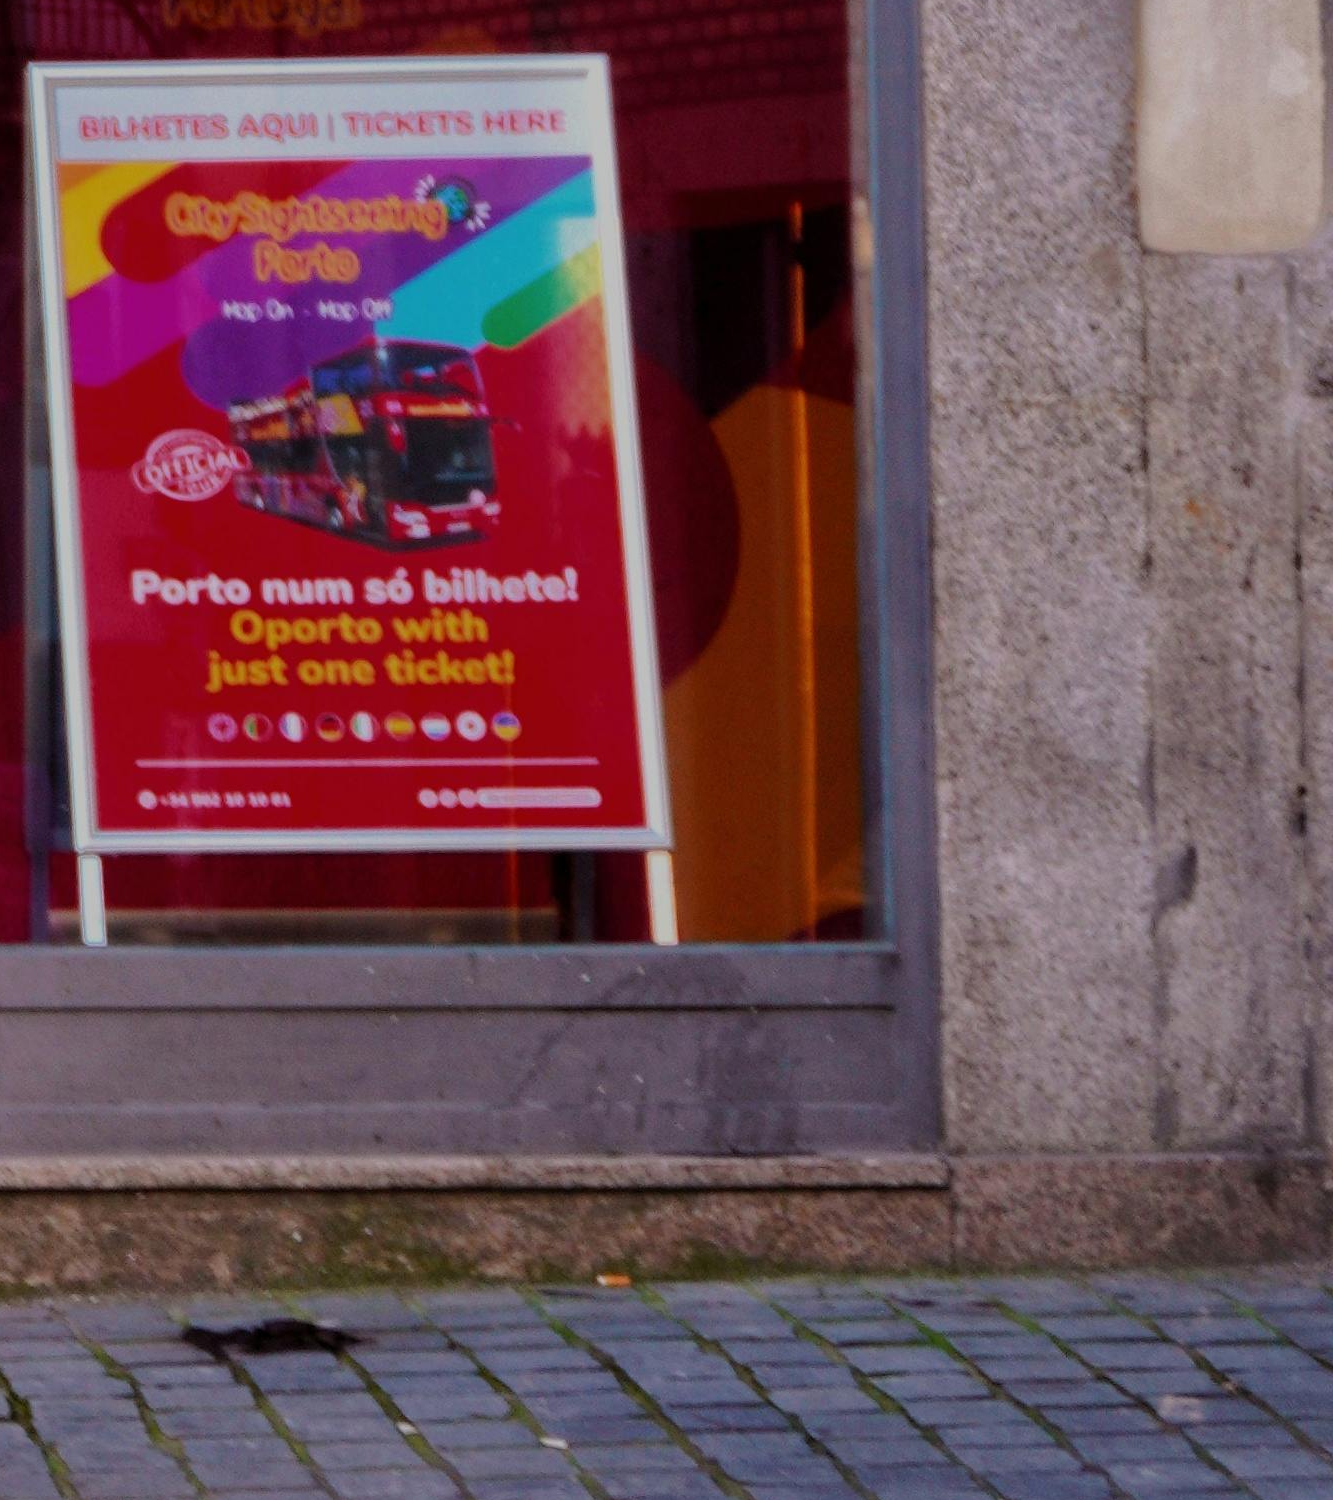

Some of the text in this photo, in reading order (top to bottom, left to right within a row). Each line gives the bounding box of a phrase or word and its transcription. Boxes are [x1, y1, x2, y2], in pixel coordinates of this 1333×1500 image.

[79, 113, 229, 143] BILHETES
[238, 112, 318, 143] AQUI
[342, 110, 474, 138] TICKETS
[482, 109, 567, 136] HERE
[131, 567, 580, 607] Porto num só bilhete!
[229, 608, 489, 651] Oporto with
[206, 651, 515, 693] just one ticket!
